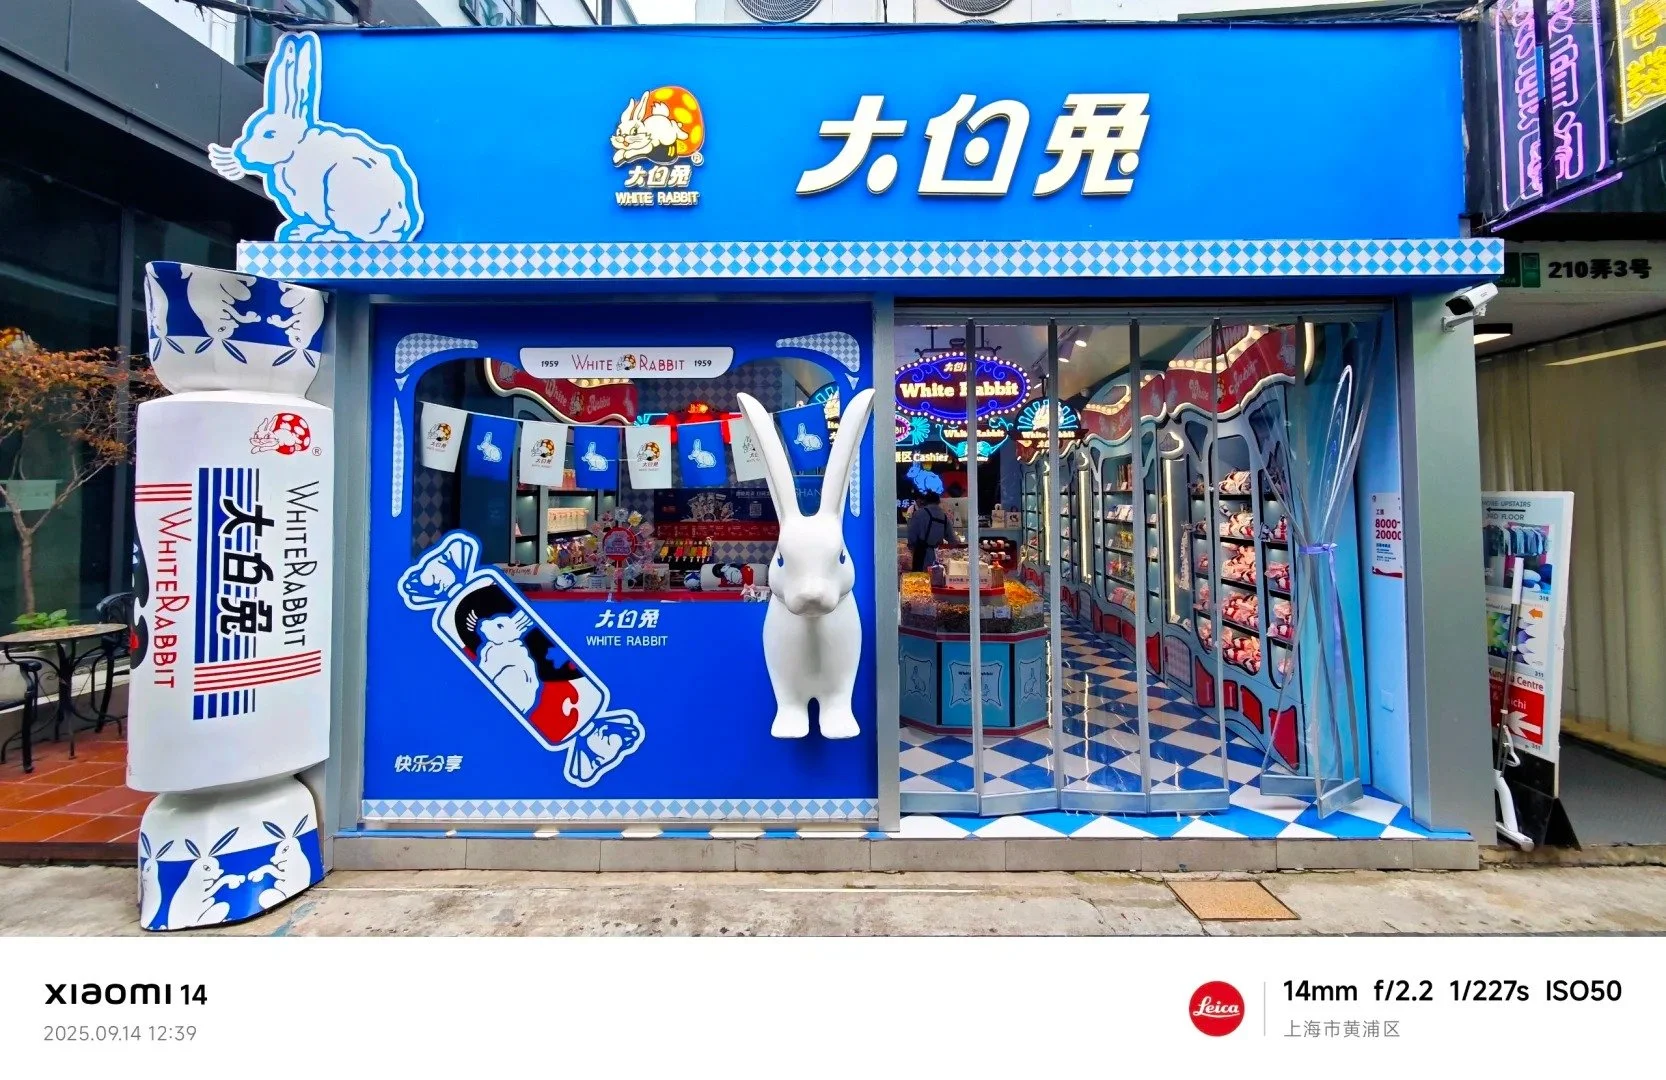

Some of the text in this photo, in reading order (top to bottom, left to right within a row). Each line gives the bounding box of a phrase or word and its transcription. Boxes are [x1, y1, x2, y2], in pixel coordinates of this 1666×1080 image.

[795, 93, 1150, 198] 大白兔
[624, 165, 691, 188] 大白兔
[615, 191, 700, 206] WHITE RABBIT
[1548, 258, 1652, 280] 210弄3号
[541, 354, 712, 371] 1959 WHITE RABBIT 1959
[899, 383, 955, 398] White
[913, 453, 949, 462] Cashier
[221, 497, 275, 635] 大白兔
[594, 608, 660, 629] 大白兔
[586, 635, 668, 646] WHITE RABBIT
[1516, 676, 1544, 692] Centre
[394, 754, 464, 773] 快乐分享
